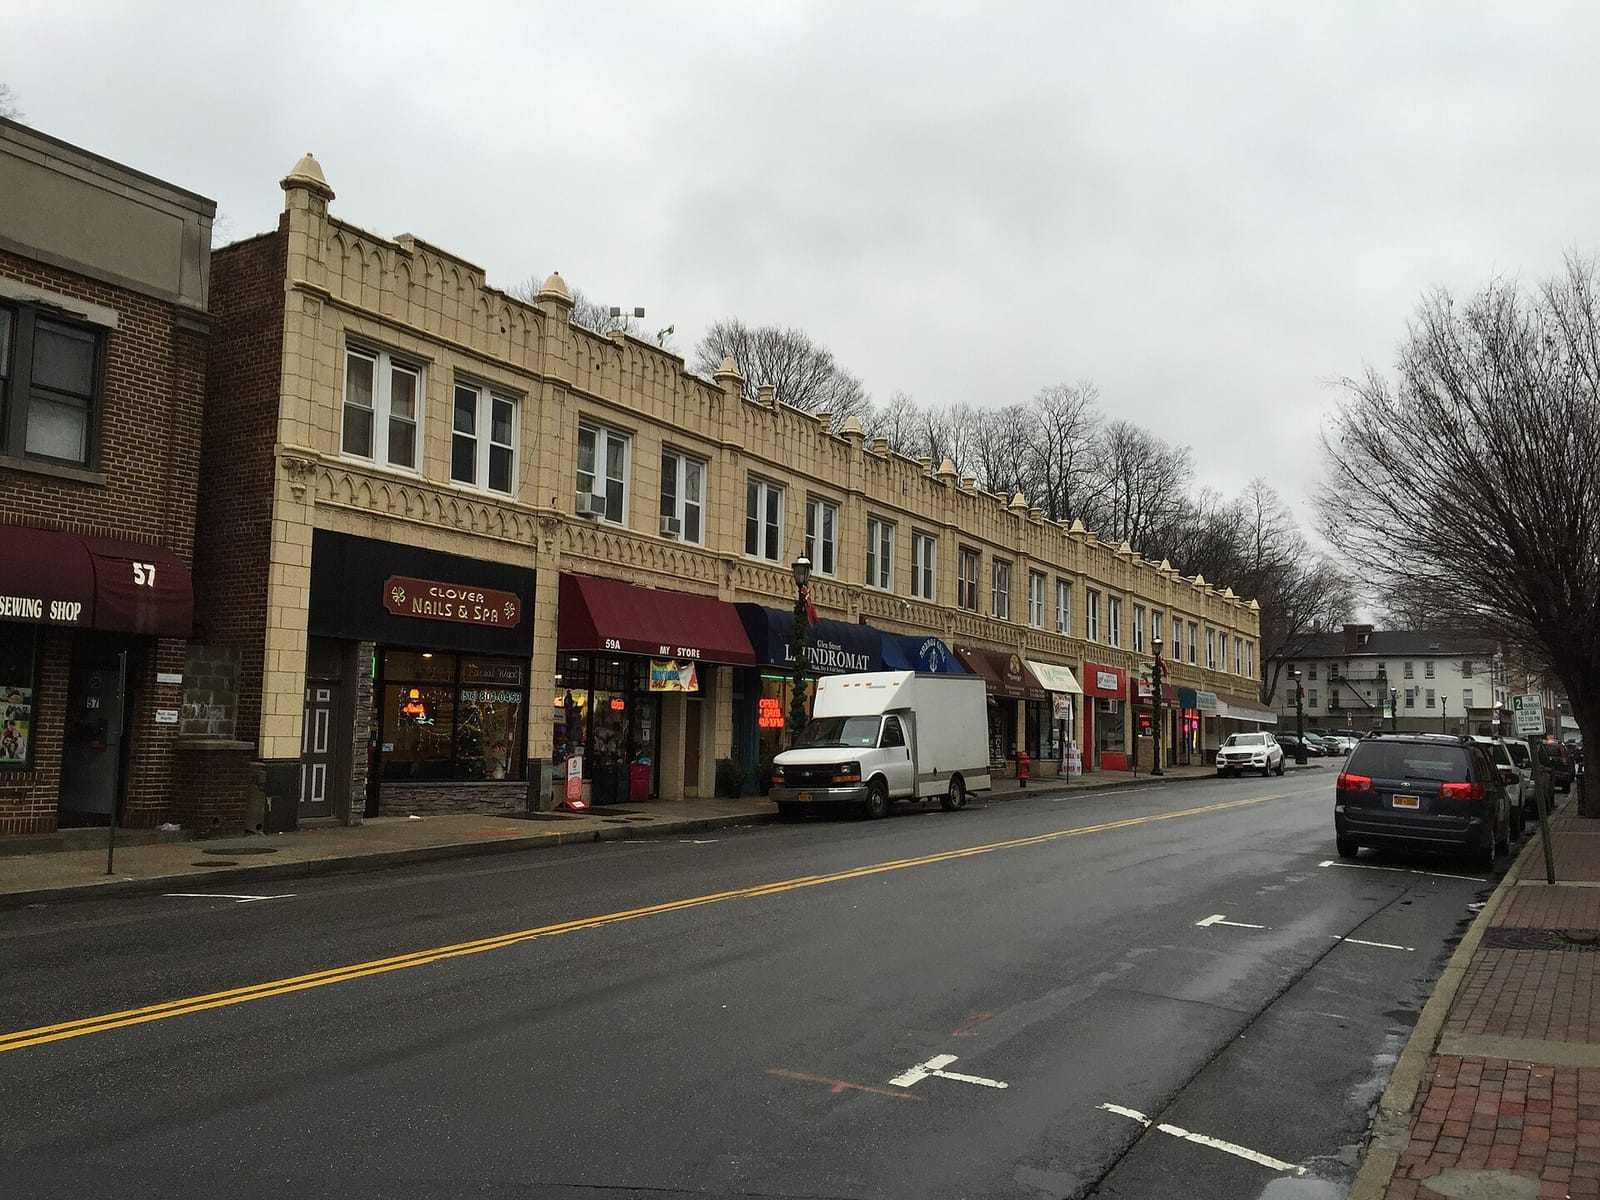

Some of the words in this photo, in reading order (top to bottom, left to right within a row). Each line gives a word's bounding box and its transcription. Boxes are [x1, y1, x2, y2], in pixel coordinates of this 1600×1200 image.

[133, 562, 156, 587] 57
[429, 587, 484, 603] CLOVER
[0, 595, 43, 618] SEWING
[50, 600, 81, 620] SHOP
[412, 598, 452, 617] NAILS
[458, 605, 468, 619] &
[473, 606, 498, 622] SPA
[605, 639, 621, 650] 59A
[660, 645, 671, 655] MY
[677, 647, 700, 658] STORE
[785, 644, 870, 670] LUNDROMAT
[759, 698, 779, 708] OPEN
[1515, 699, 1521, 709] 2
